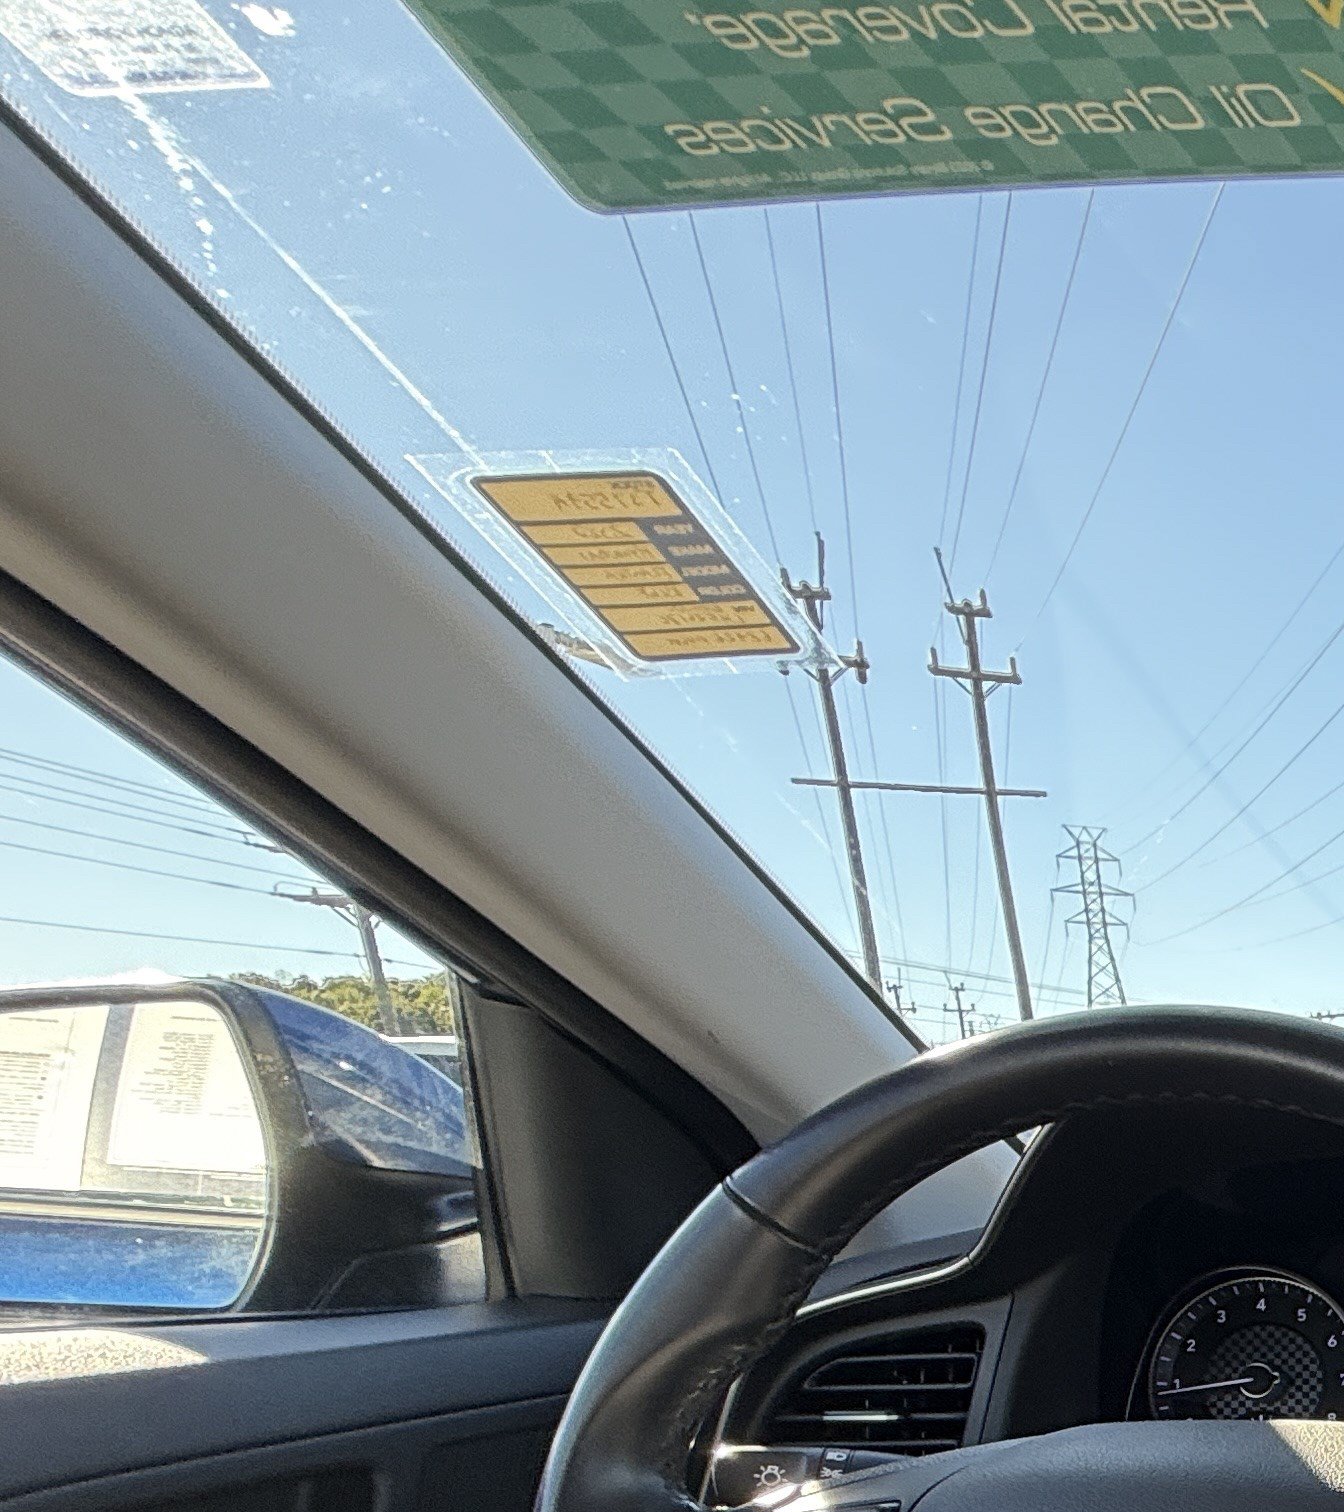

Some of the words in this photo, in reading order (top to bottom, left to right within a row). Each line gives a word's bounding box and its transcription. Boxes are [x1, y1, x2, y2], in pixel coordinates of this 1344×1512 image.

[1257, 1298, 1266, 1313] 4
[1216, 1309, 1226, 1323] 3
[1297, 1307, 1307, 1322] 5
[1186, 1339, 1196, 1353] 2
[1327, 1335, 1338, 1349] 6
